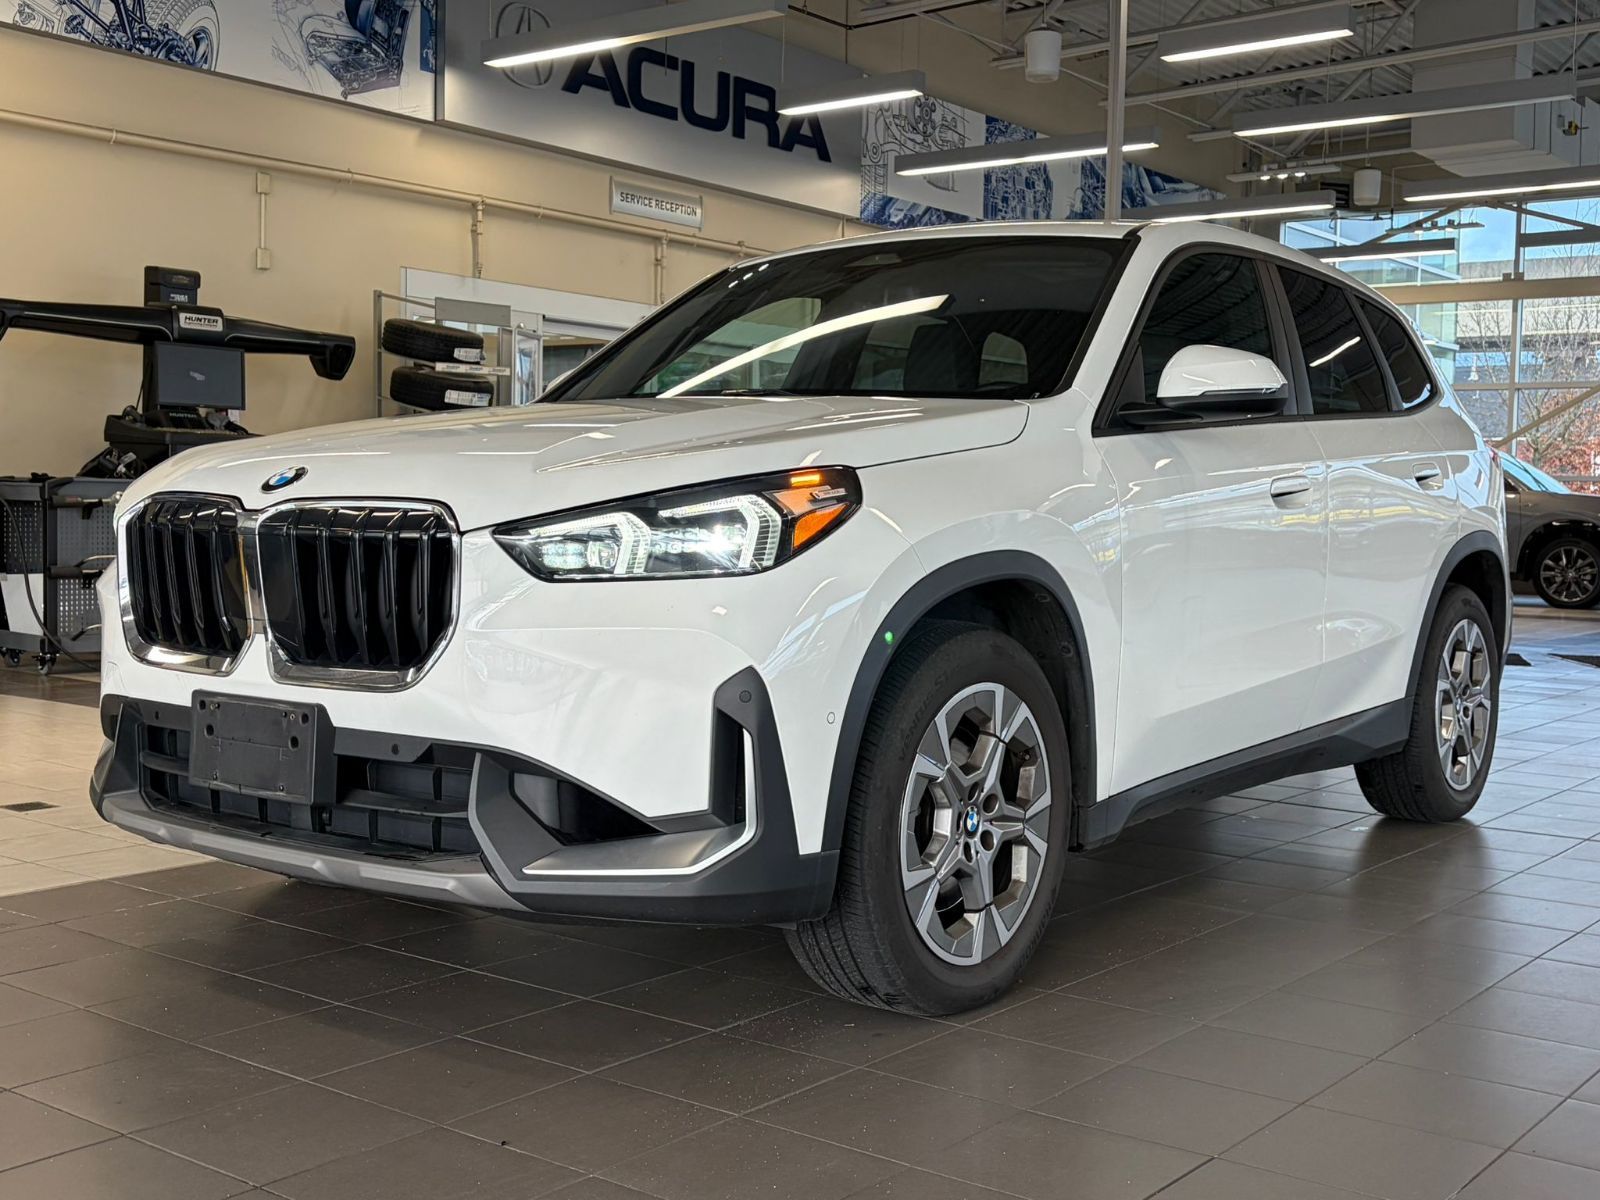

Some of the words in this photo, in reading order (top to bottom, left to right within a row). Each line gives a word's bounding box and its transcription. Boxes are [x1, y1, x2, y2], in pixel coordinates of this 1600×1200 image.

[561, 46, 832, 163] ACURA
[619, 191, 653, 208] SERVICE
[654, 199, 697, 217] RECEPTION
[184, 315, 219, 324] HUNTER
